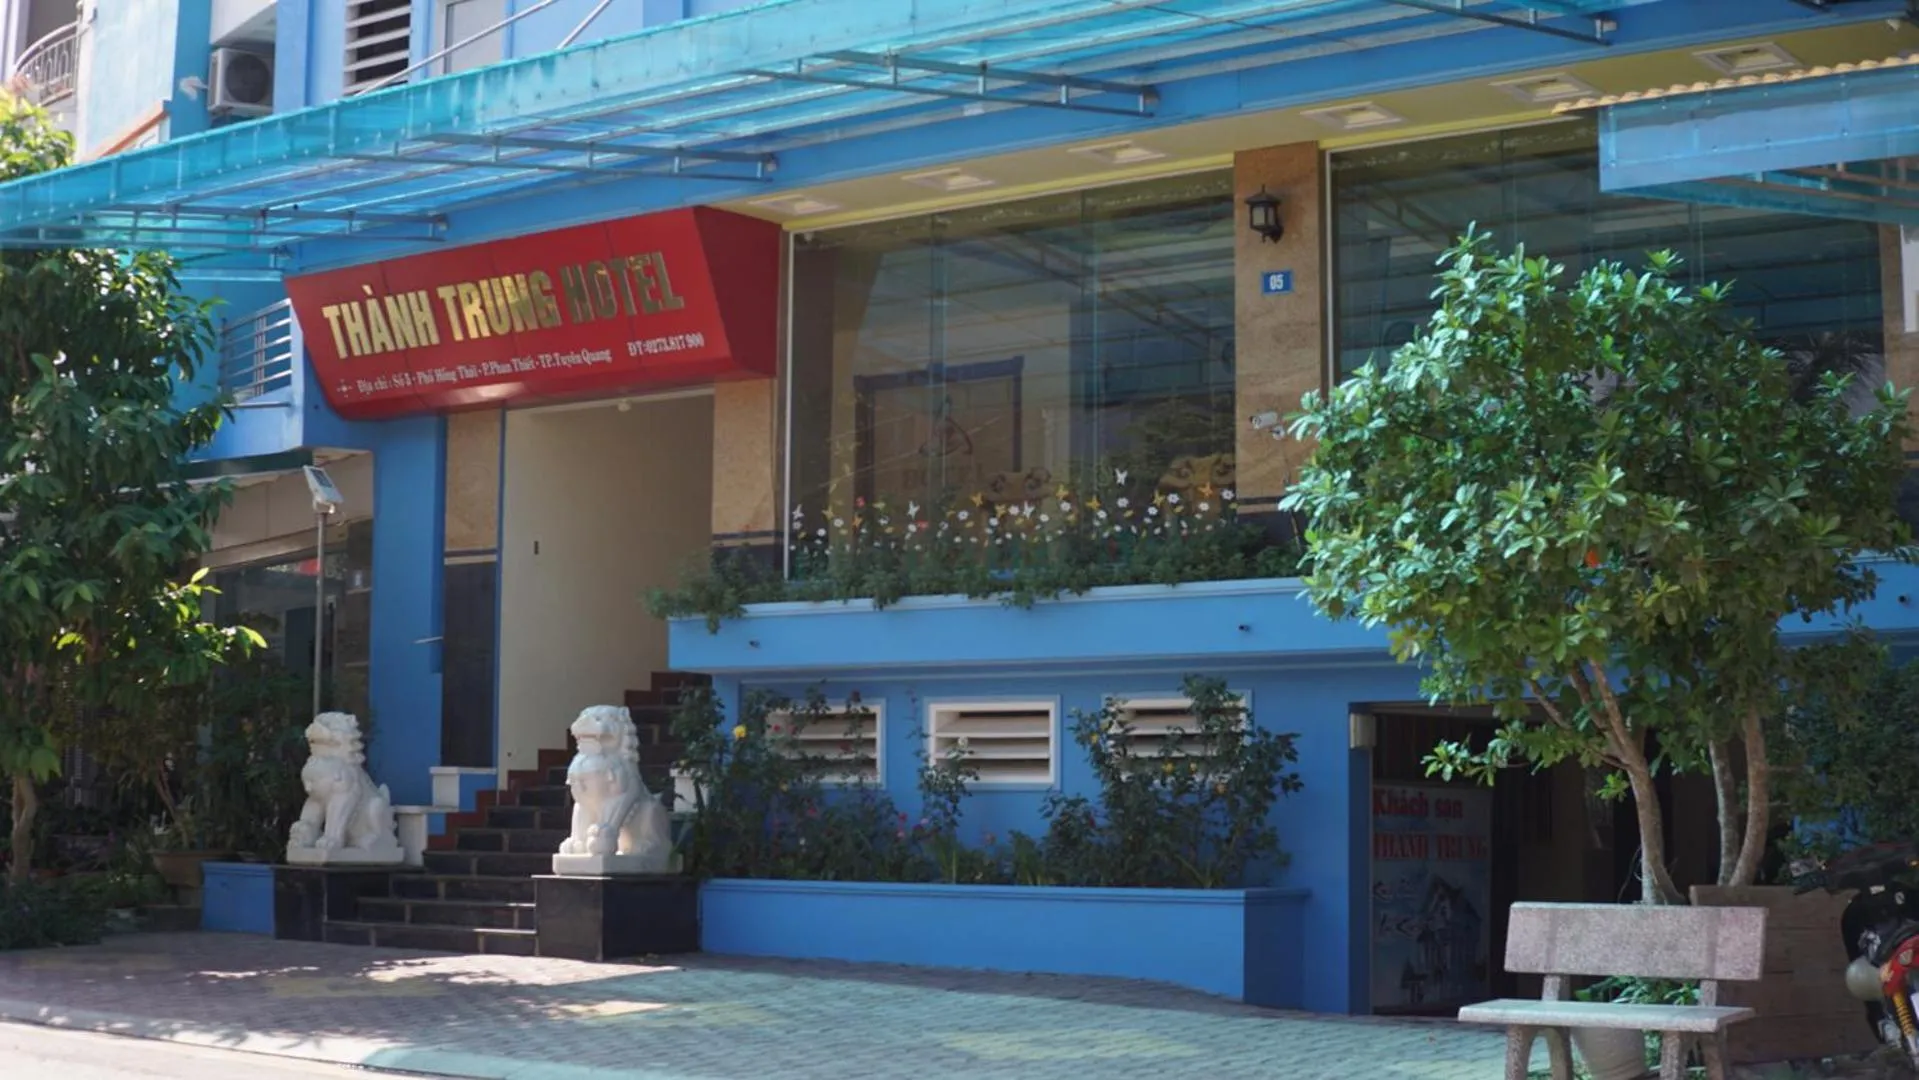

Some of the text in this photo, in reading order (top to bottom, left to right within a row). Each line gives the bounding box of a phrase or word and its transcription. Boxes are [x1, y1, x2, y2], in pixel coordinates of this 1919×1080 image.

[1269, 274, 1284, 290] 05
[322, 251, 684, 359] THÀNH TRUNG HOTEL
[581, 347, 613, 365] Quang
[1373, 788, 1428, 817] Khách
